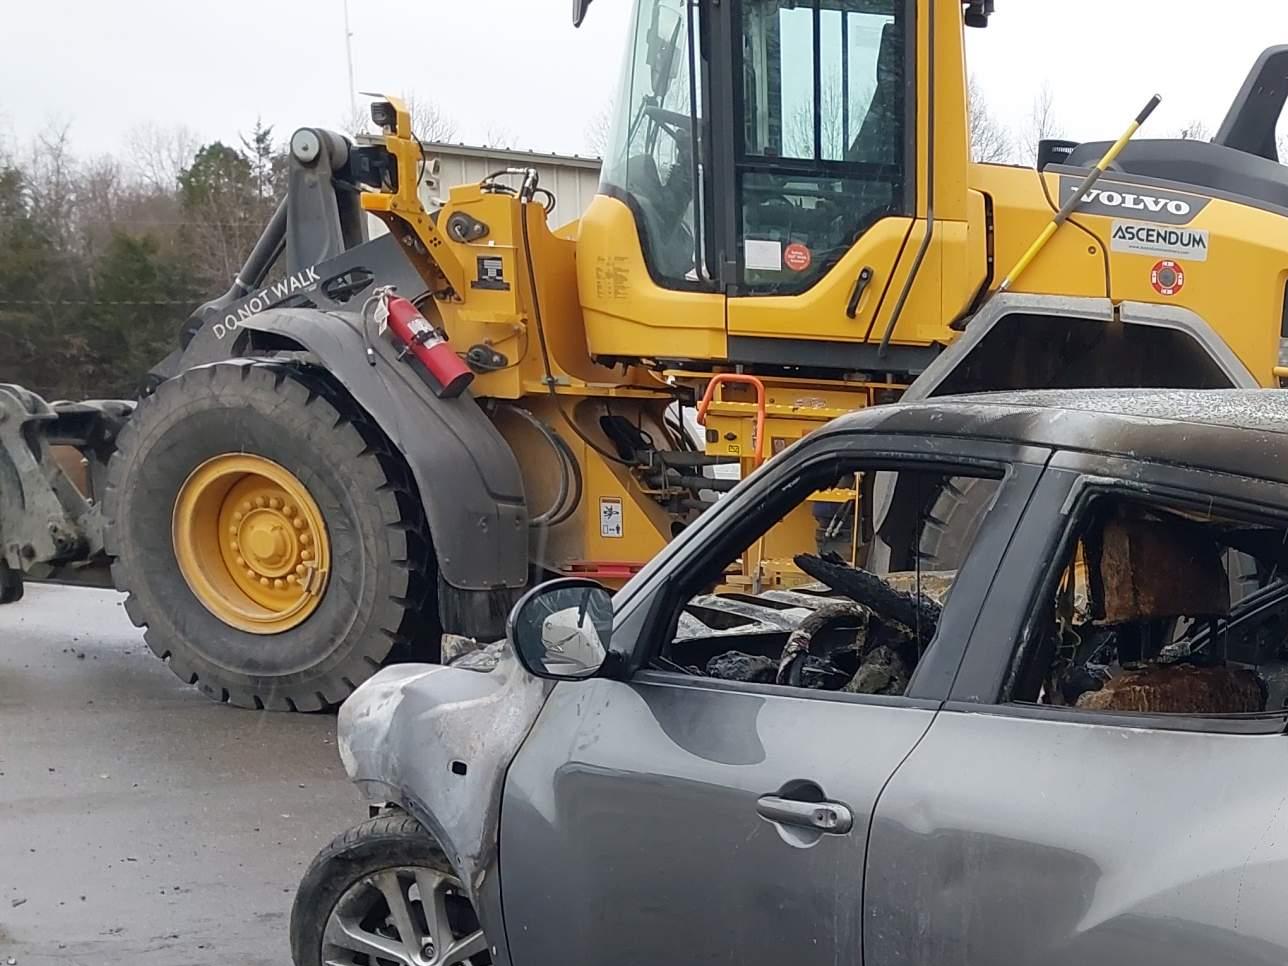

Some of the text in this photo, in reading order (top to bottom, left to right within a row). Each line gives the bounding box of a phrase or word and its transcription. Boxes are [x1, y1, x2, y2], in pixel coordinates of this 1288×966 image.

[1070, 186, 1190, 215] VOLVO
[1112, 225, 1206, 249] ASCENDUM
[212, 265, 321, 339] DO NOT WALK
